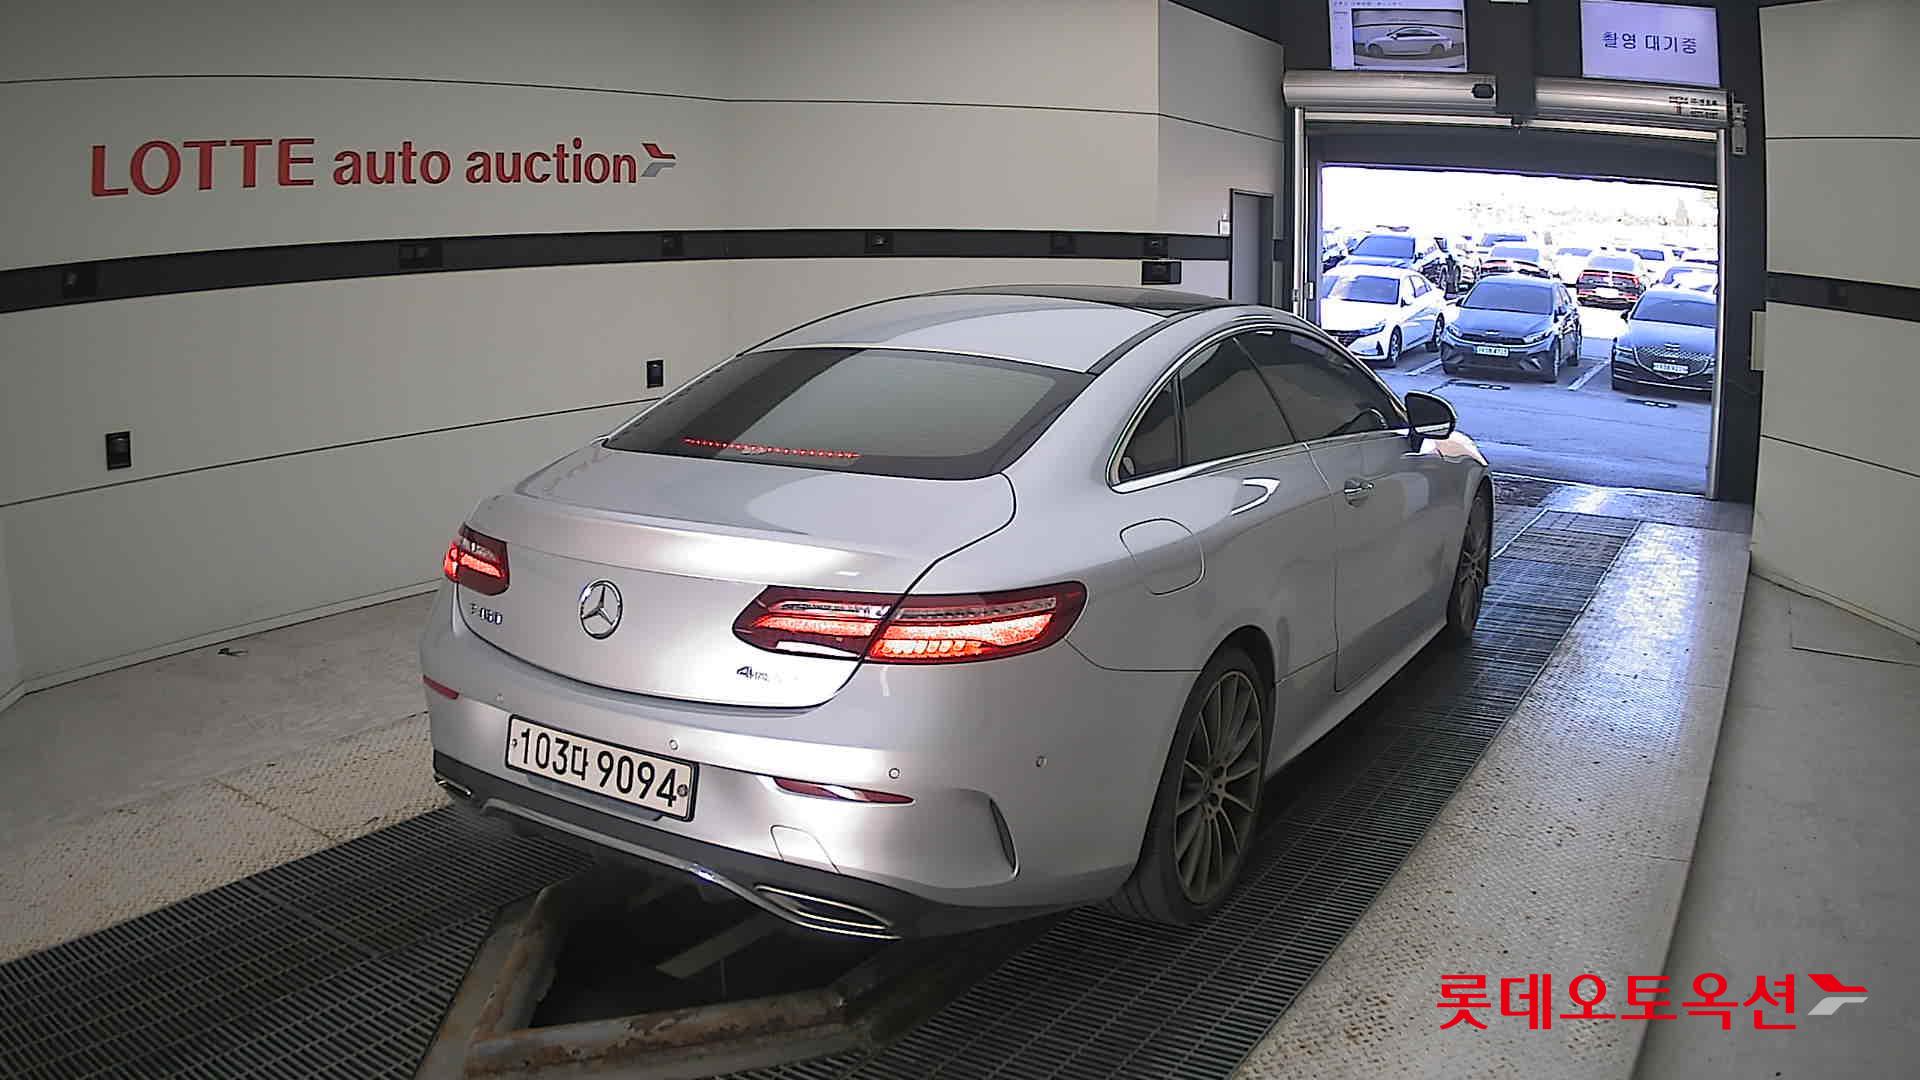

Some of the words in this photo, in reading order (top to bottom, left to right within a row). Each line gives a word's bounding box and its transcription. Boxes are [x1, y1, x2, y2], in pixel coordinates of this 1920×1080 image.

[1644, 34, 1697, 55] 대기중
[92, 138, 315, 197] LOTTE
[333, 140, 451, 185] auto
[466, 137, 637, 184] auction
[597, 750, 678, 808] 9094
